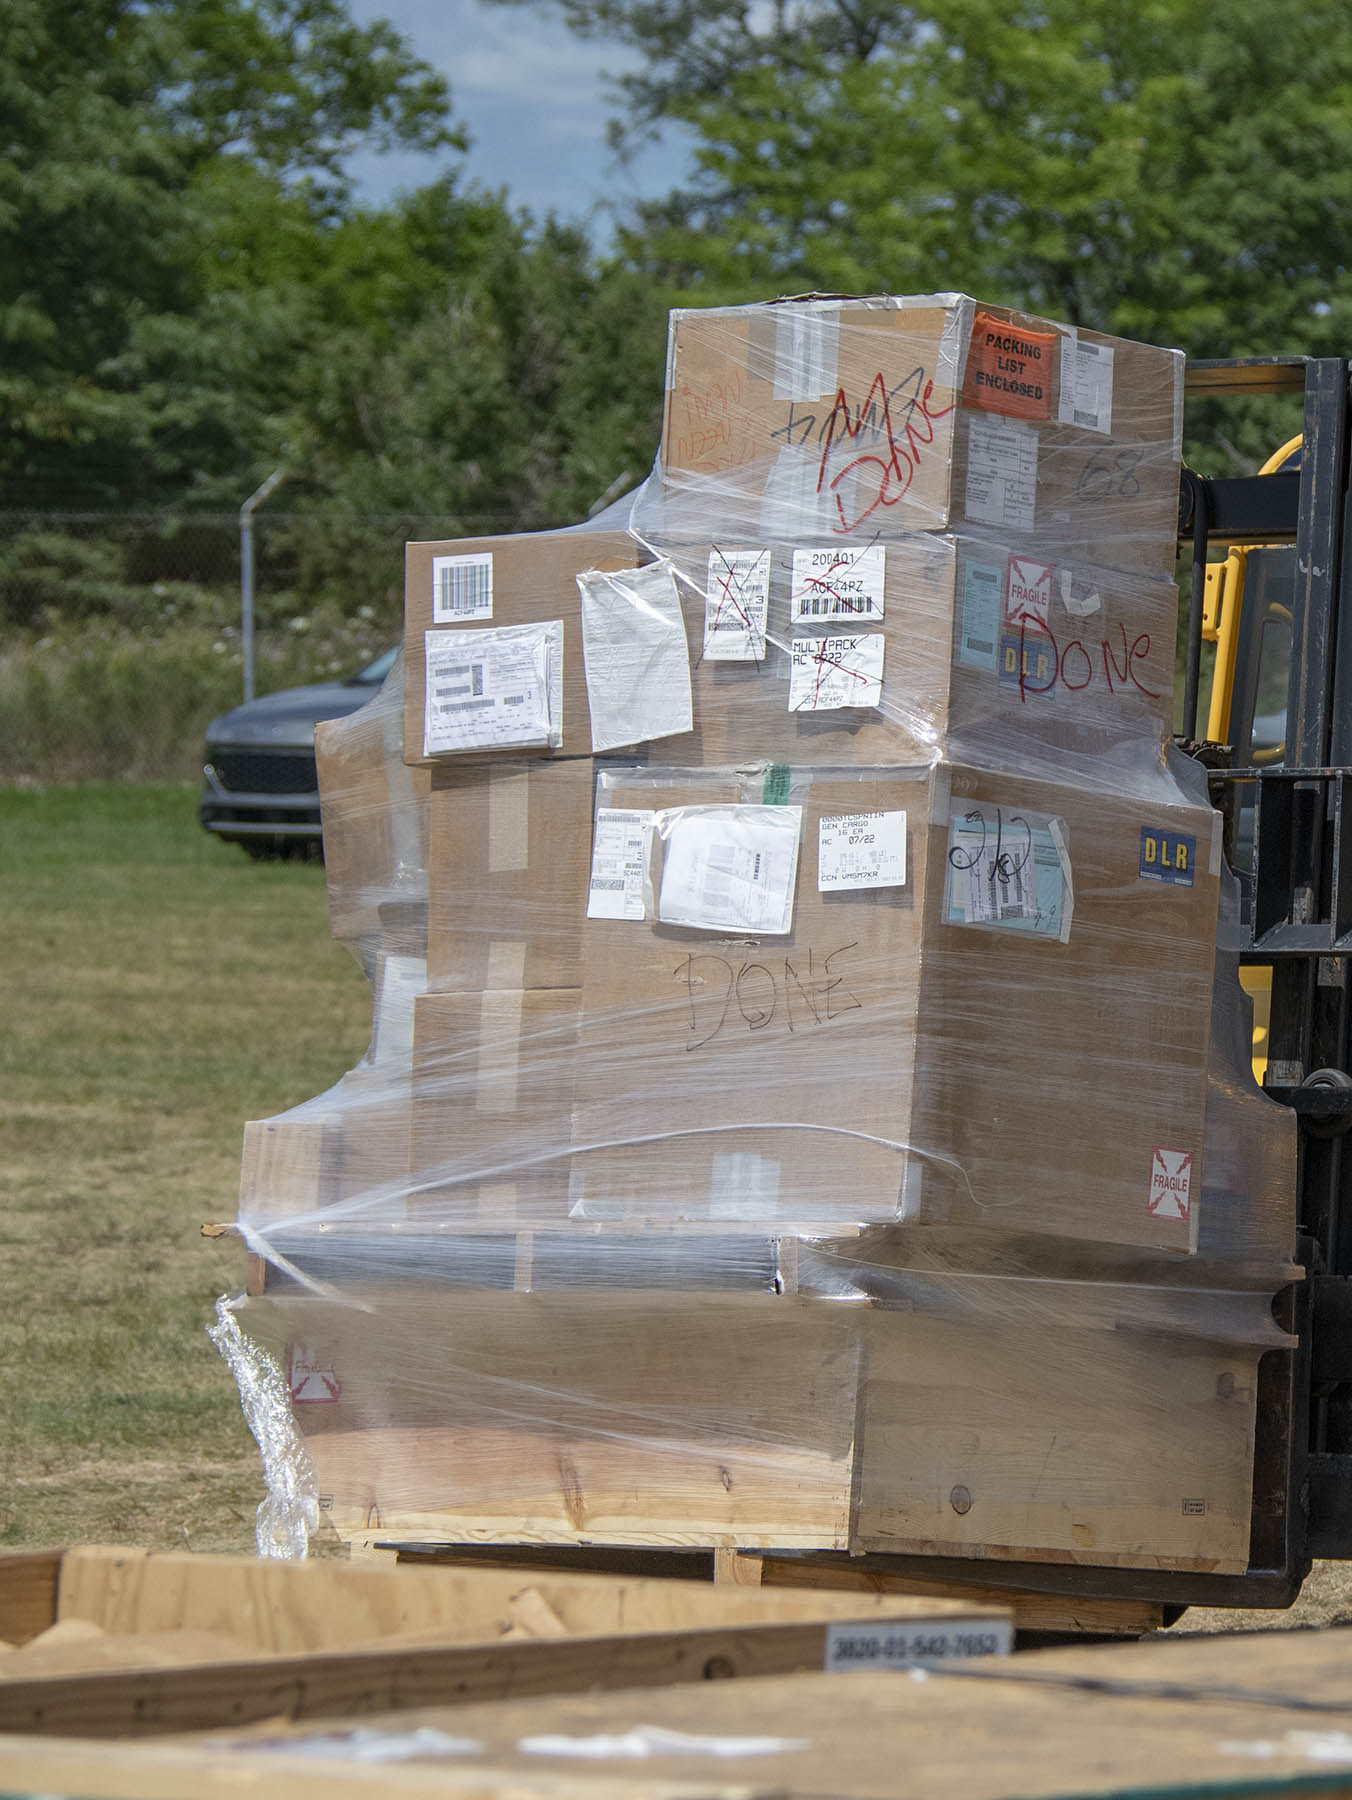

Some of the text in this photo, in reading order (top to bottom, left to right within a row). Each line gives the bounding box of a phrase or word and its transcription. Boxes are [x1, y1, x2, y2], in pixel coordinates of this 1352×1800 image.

[985, 333, 1042, 360] PACKING
[997, 356, 1026, 375] LIST
[975, 370, 1043, 400] ENCLOSED
[1011, 584, 1047, 605] FRAGILE
[793, 638, 857, 653] MULTIPACK
[793, 654, 807, 665] AC
[842, 820, 869, 829] CARGO
[848, 834, 875, 845] 07/22
[1145, 837, 1188, 870] DLR
[673, 942, 862, 1052] DONE
[1153, 1174, 1188, 1192] FRAGILE
